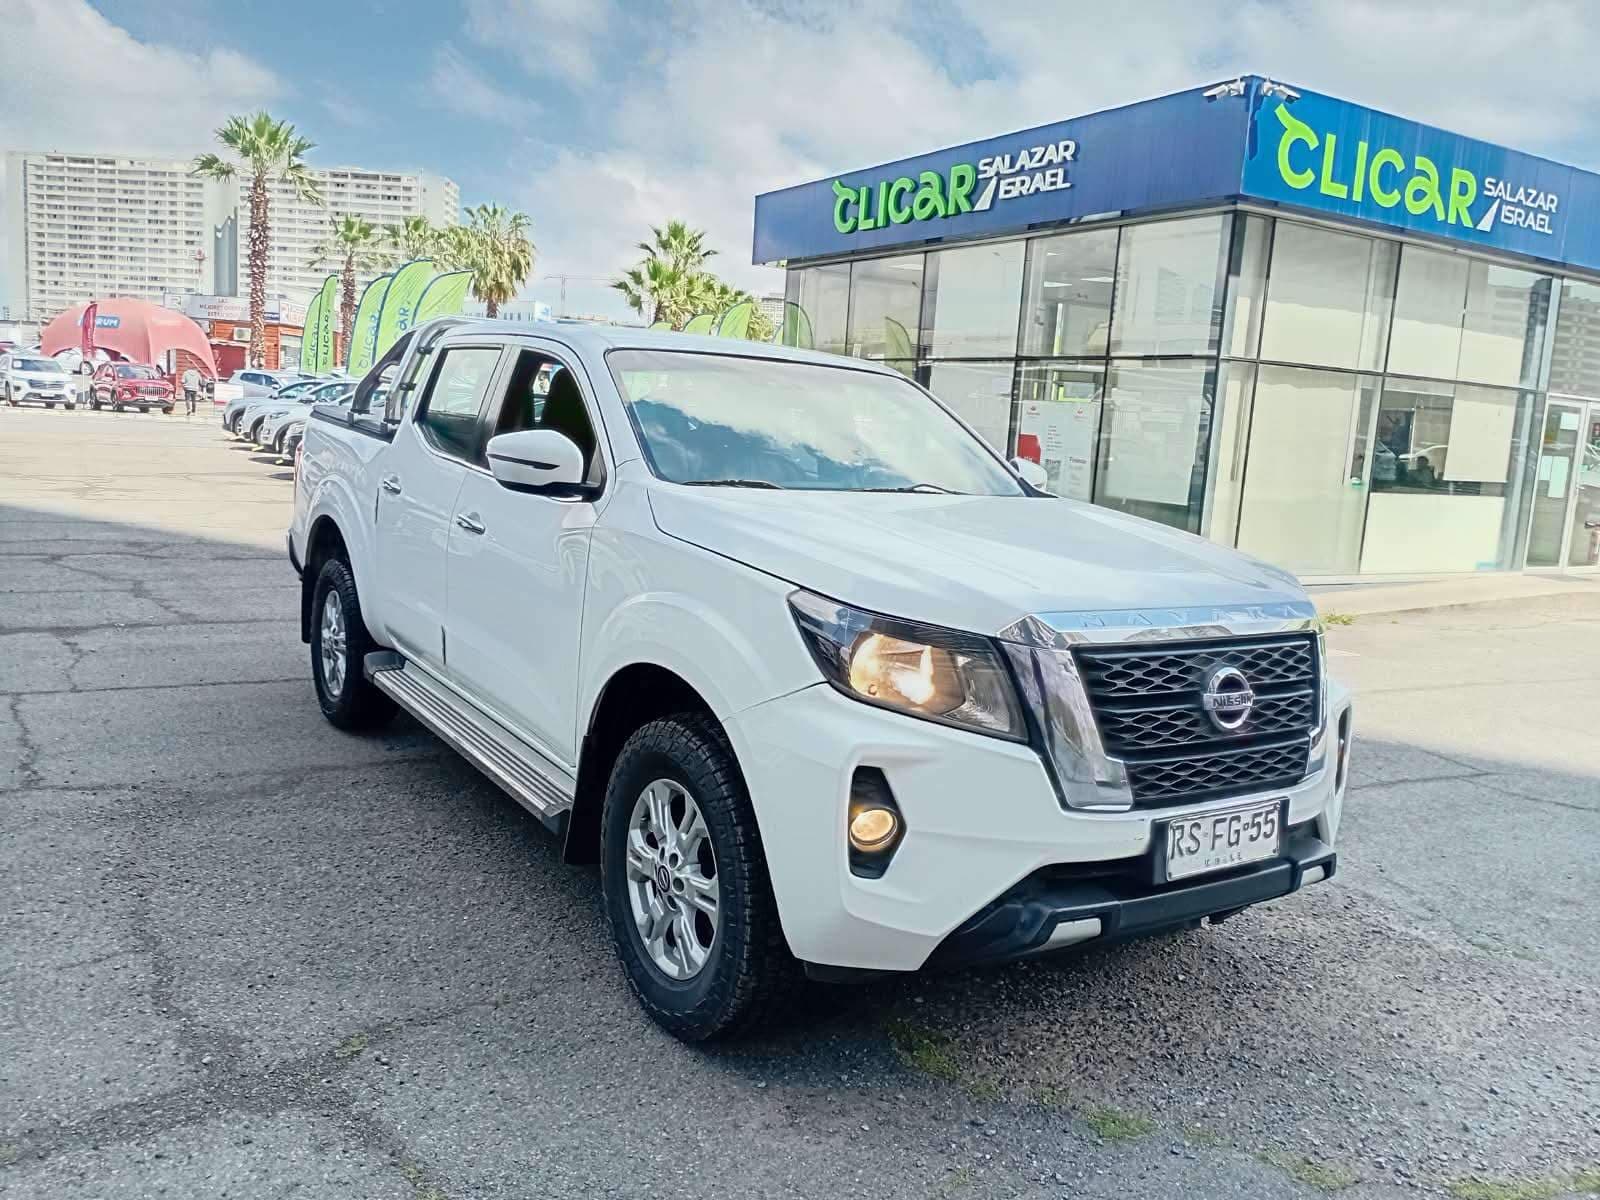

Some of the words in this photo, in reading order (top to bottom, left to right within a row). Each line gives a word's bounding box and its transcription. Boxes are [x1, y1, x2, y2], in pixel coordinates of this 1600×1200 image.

[977, 140, 1076, 179] SALAZAR
[998, 167, 1073, 199] ISRAEL
[1483, 177, 1558, 213] SALAZAR
[1500, 204, 1553, 234] ISRAEL
[1212, 693, 1253, 708] NISSAN
